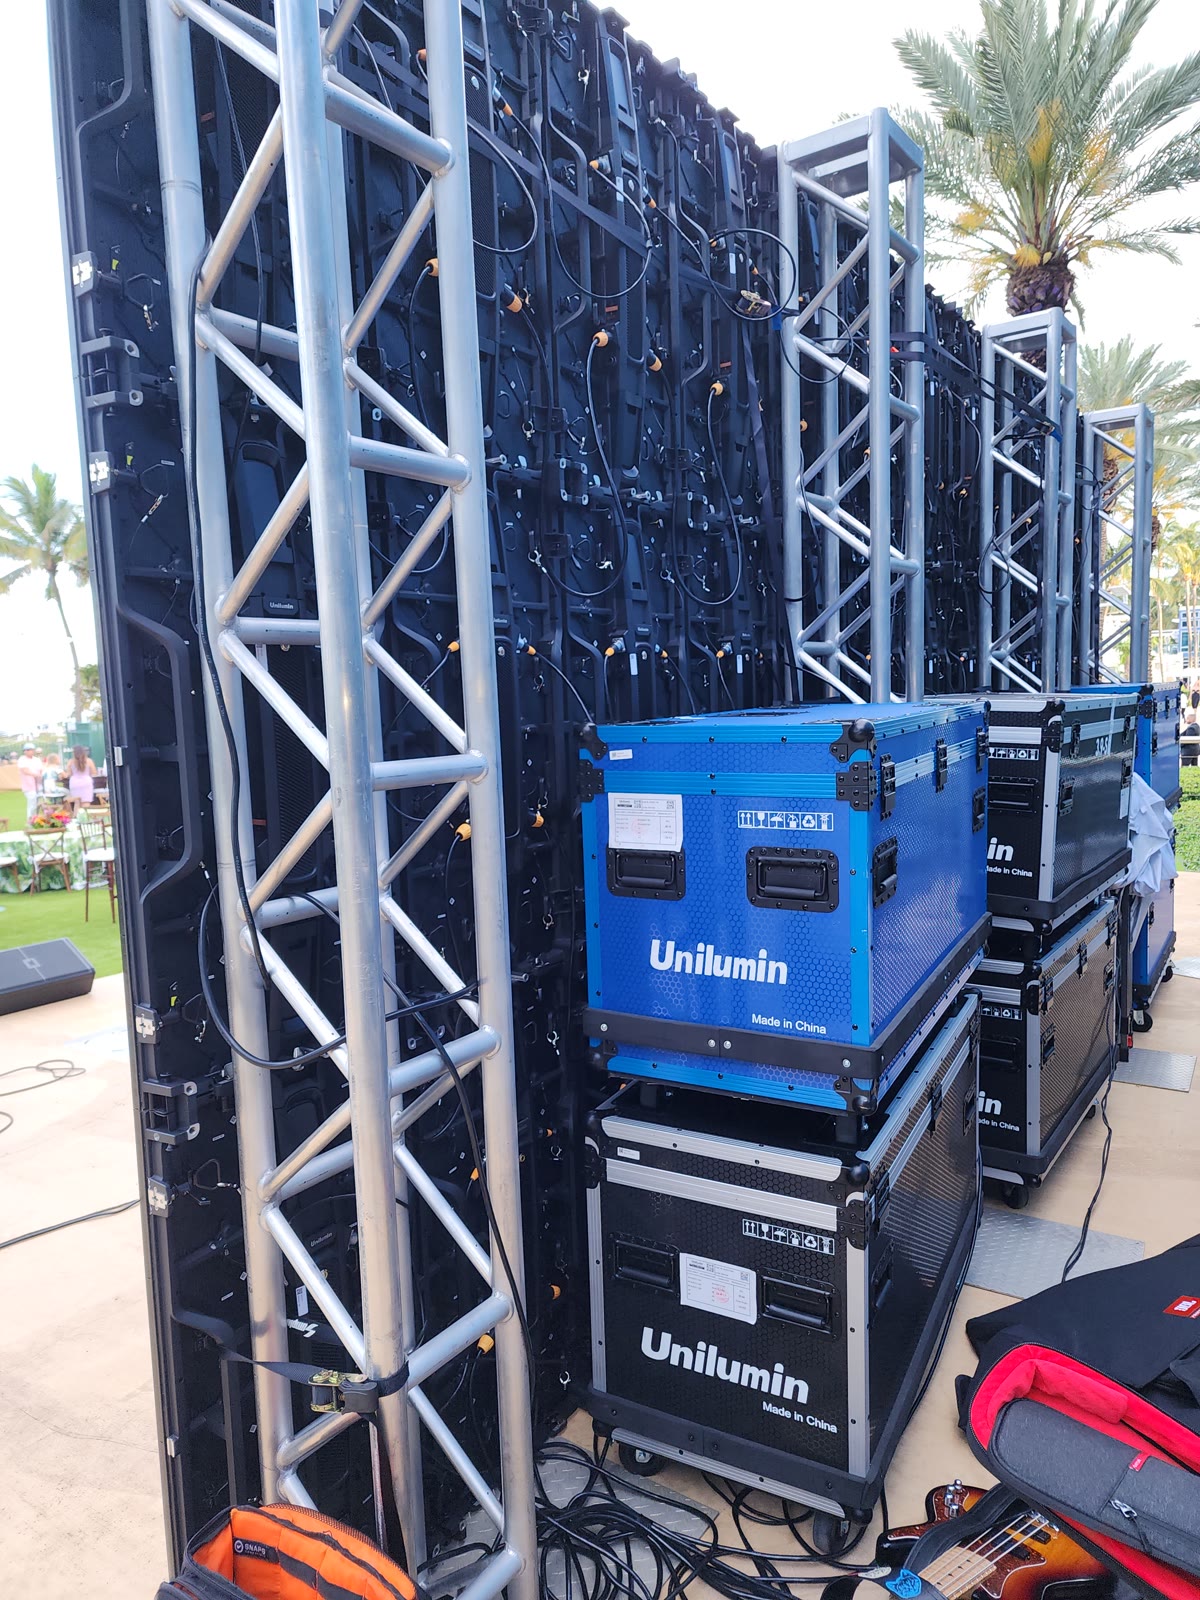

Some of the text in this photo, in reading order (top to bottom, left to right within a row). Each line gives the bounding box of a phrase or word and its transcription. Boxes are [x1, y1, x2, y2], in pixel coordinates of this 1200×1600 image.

[269, 601, 294, 610] Unilumin
[1003, 867, 1010, 875] in
[1011, 868, 1033, 878] China
[649, 939, 788, 985] Unilumin
[751, 1013, 827, 1035] Made in China
[991, 1119, 998, 1127] in
[999, 1121, 1020, 1132] China
[640, 1326, 809, 1404] Unilumin
[762, 1401, 838, 1434] Made in China
